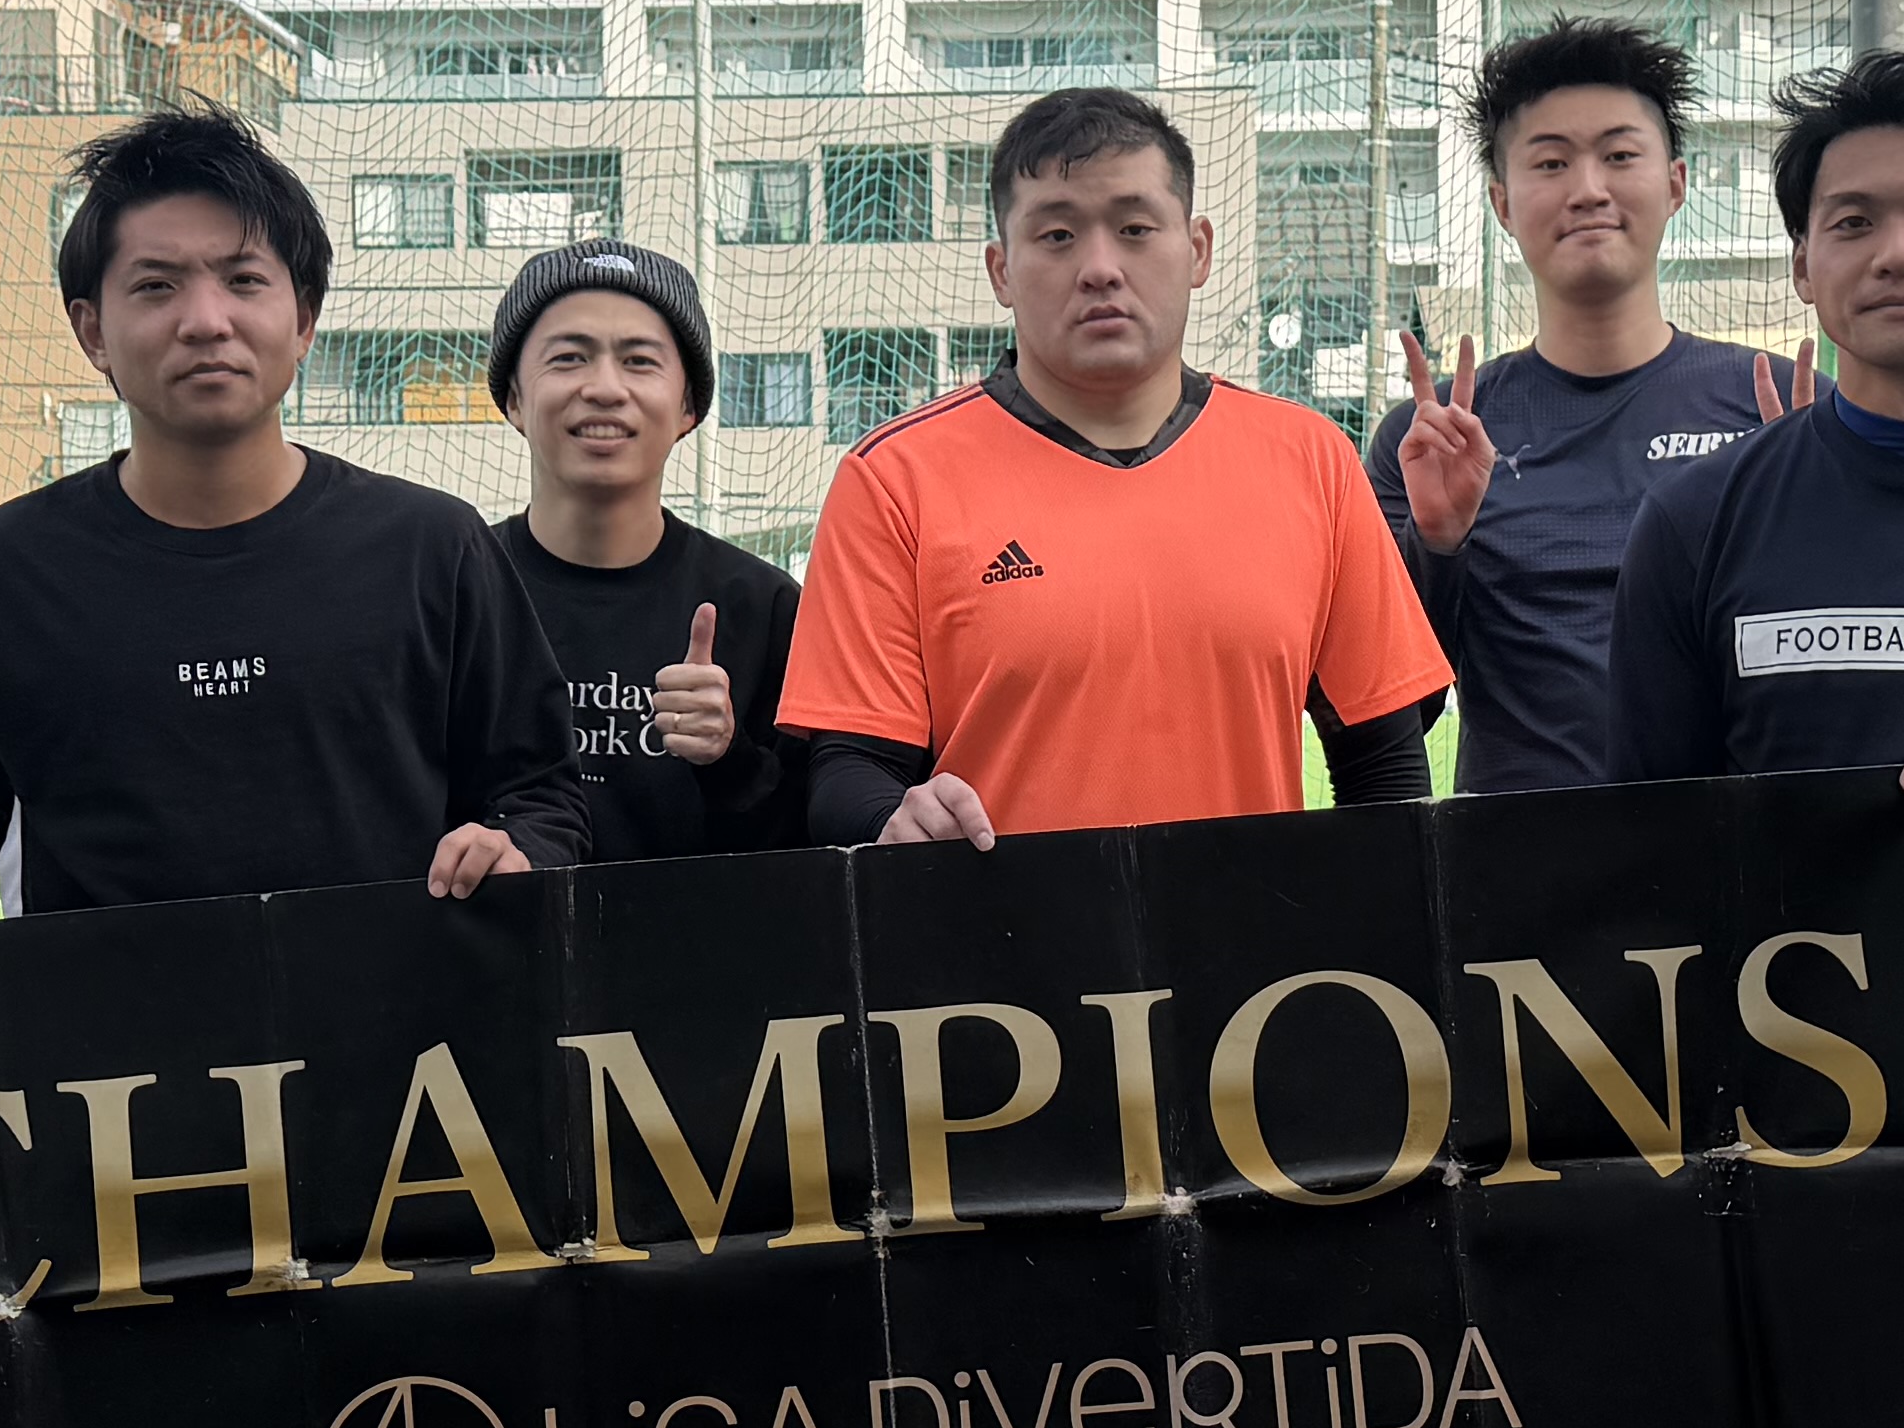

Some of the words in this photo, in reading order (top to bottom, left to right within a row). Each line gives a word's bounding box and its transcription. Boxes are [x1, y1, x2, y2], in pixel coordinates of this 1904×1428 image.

[1647, 428, 1756, 460] SEIR
[981, 564, 1045, 585] adidas
[178, 657, 266, 682] BEAMS
[194, 680, 250, 697] HEART
[639, 720, 680, 757] C
